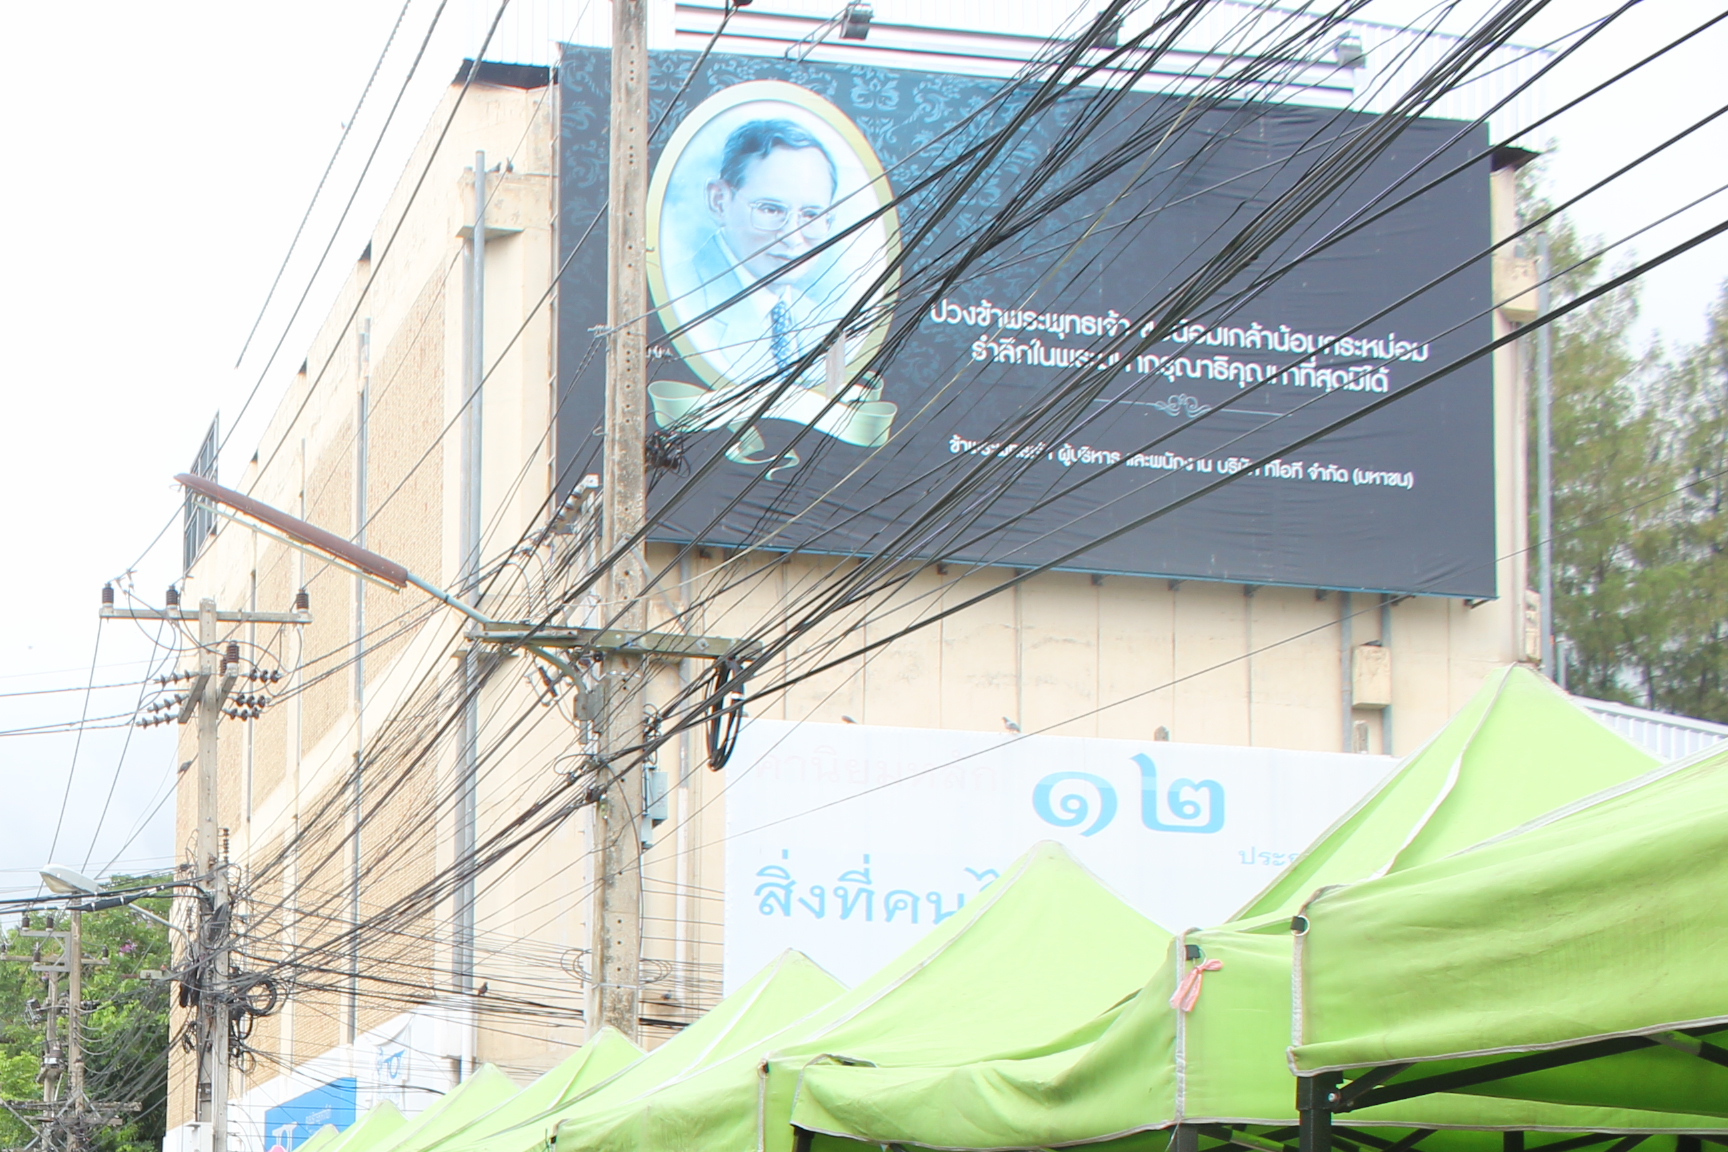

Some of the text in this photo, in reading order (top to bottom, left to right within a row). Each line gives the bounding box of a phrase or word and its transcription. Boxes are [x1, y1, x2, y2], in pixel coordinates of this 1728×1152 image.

[1140, 318, 1430, 363] ขน้อมเกล้าน้อมกระหม่อม
[1307, 463, 1348, 483] จำกัด
[1353, 467, 1414, 490] (มหาชน)
